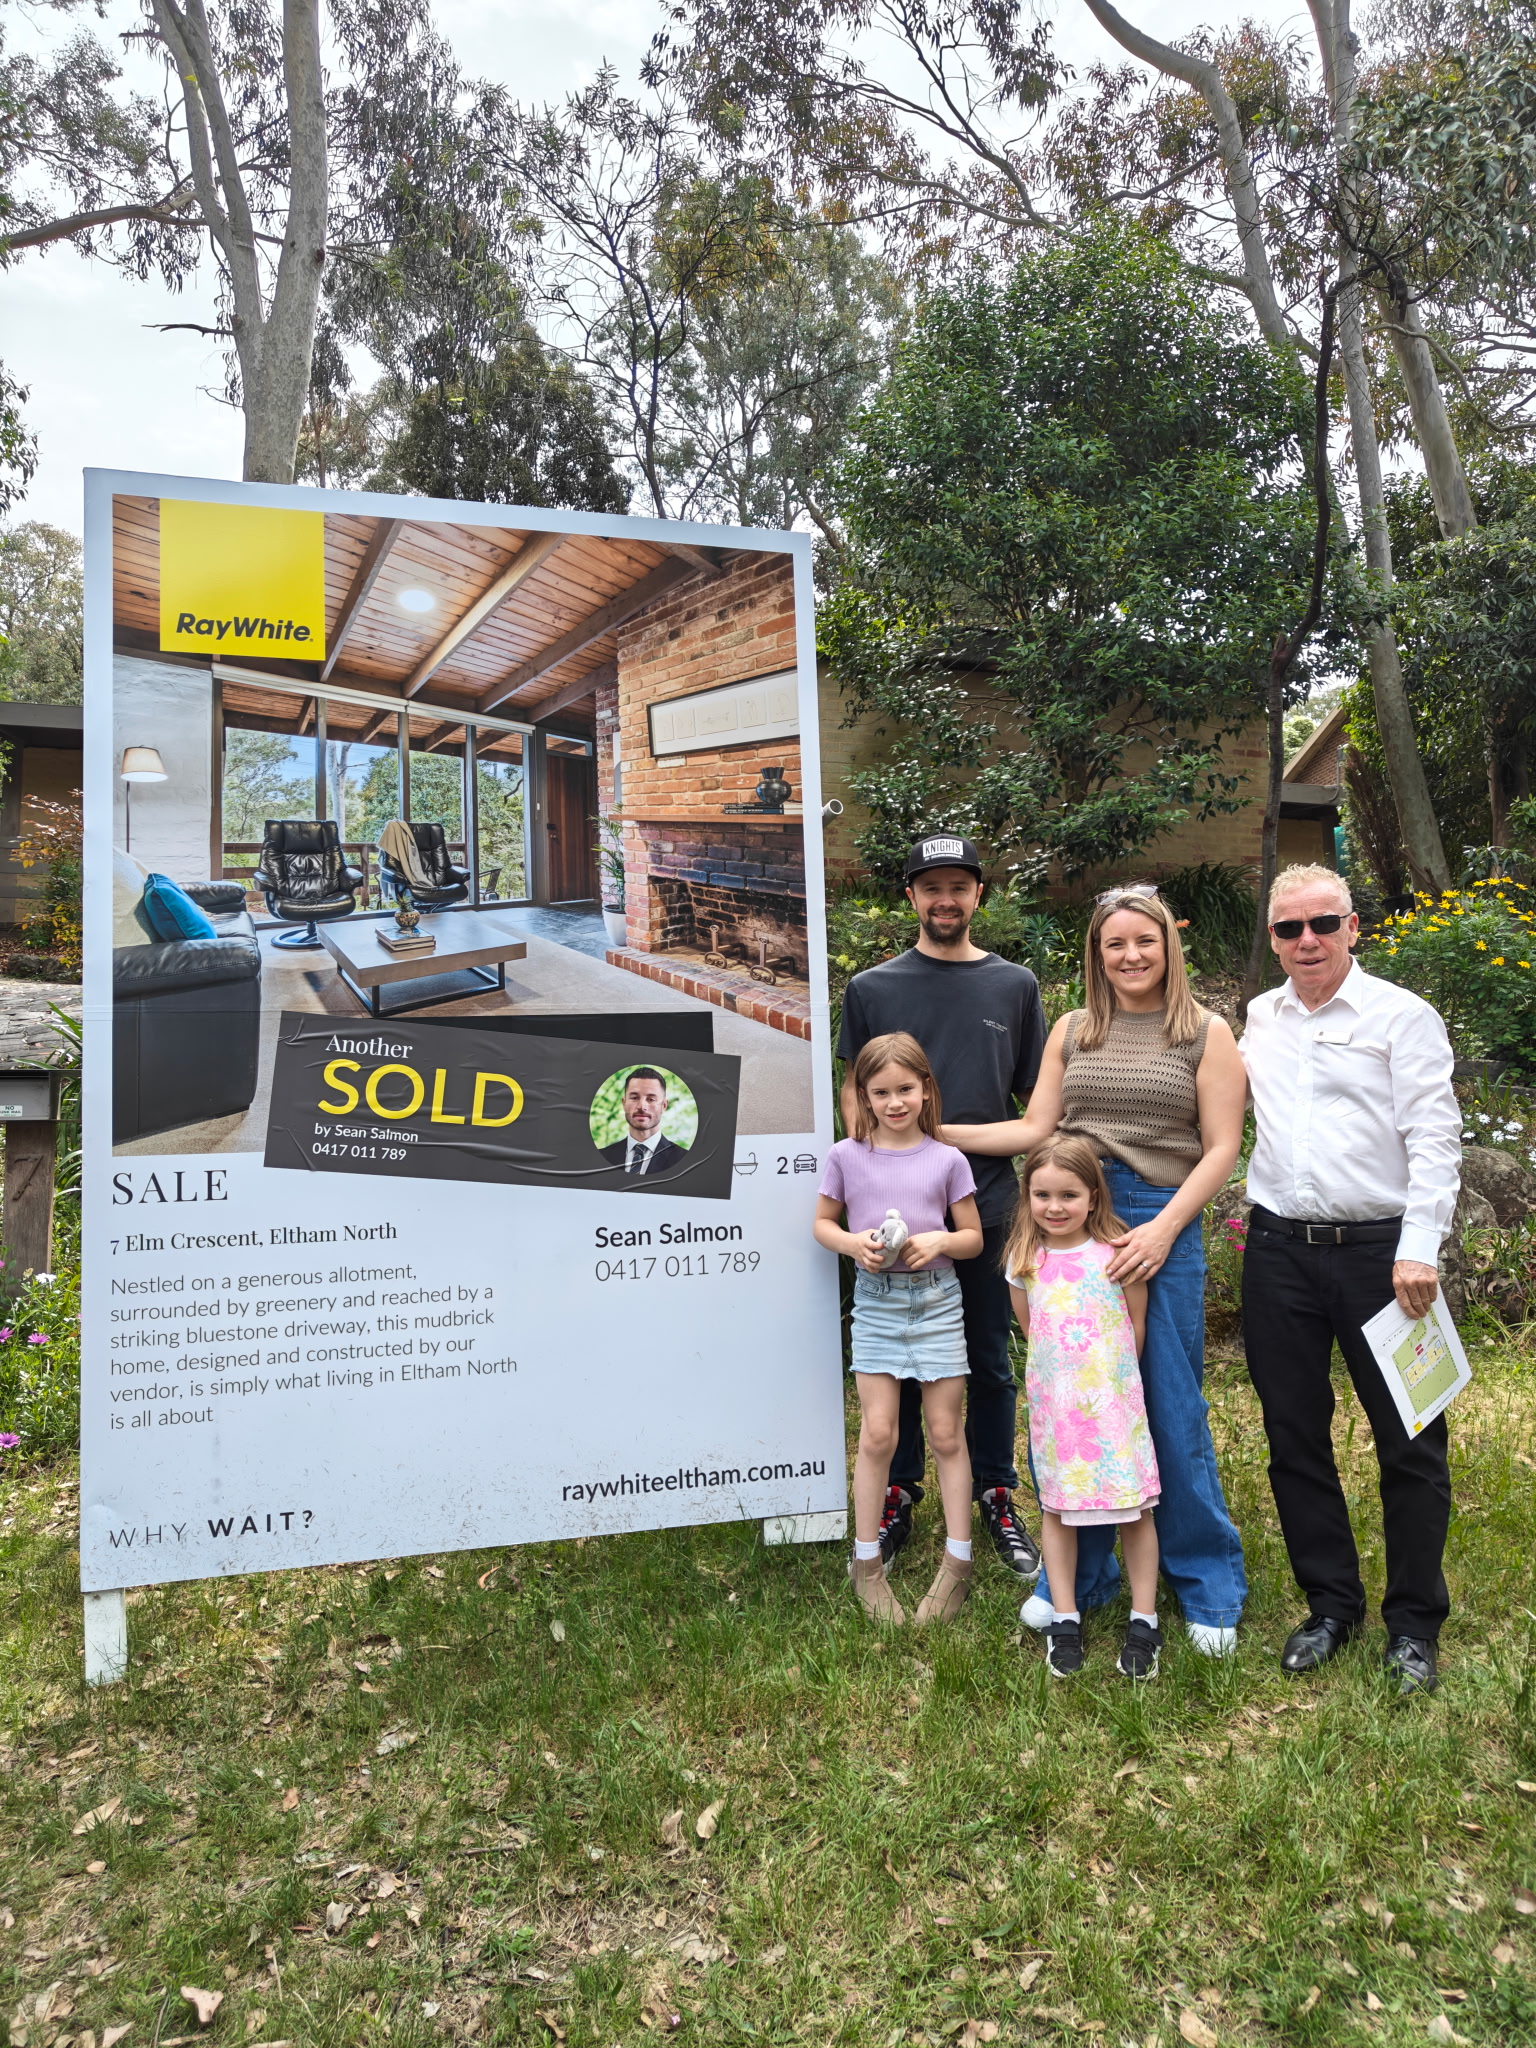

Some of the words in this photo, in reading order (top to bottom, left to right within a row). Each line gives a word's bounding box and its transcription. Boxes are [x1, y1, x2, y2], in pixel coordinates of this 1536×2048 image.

[925, 840, 962, 855] KNIGHTS
[324, 1034, 414, 1059] Another
[317, 1058, 524, 1128] SOLD
[314, 1122, 332, 1138] by
[334, 1124, 367, 1139] Sean
[369, 1127, 419, 1144] Salmon
[312, 1142, 348, 1157] 0417
[350, 1145, 377, 1159] 011
[381, 1147, 407, 1161] 789
[776, 1156, 789, 1175] 2
[112, 1169, 228, 1205] SALE
[110, 1239, 120, 1256] 7
[125, 1233, 165, 1252] Elm
[170, 1230, 264, 1250] Crescent,
[270, 1226, 337, 1245] Eltham
[343, 1222, 398, 1241] North
[595, 1226, 652, 1249] Sean
[659, 1221, 743, 1245] Salmon
[111, 1274, 184, 1296] Nestled
[191, 1277, 215, 1291] on
[221, 1276, 231, 1290] a
[237, 1271, 323, 1292] generous
[328, 1263, 417, 1284] allotment,
[595, 1257, 657, 1282] 0417
[665, 1254, 709, 1278] 011
[717, 1250, 761, 1274] 789
[110, 1300, 220, 1323] surrounded
[227, 1298, 250, 1318] by
[255, 1297, 337, 1317] greenery
[342, 1290, 375, 1308] and
[382, 1285, 452, 1306] reached
[458, 1284, 479, 1304] by
[484, 1287, 493, 1300] a
[110, 1329, 180, 1349] striking
[186, 1325, 278, 1344] bluestone
[284, 1320, 371, 1338] driveway,
[376, 1314, 409, 1332] this
[414, 1308, 495, 1329] mudbrick
[111, 1358, 170, 1376] home,
[176, 1349, 260, 1372] designed
[266, 1346, 300, 1365] and
[306, 1340, 413, 1362] constructed
[419, 1338, 441, 1357] by
[446, 1338, 476, 1352] our
[110, 1382, 183, 1403] vendor,
[190, 1380, 204, 1397] is
[210, 1375, 270, 1397] simply
[275, 1372, 321, 1390] what
[327, 1368, 374, 1388] living
[379, 1366, 395, 1383] in
[401, 1363, 461, 1381] Eltham
[467, 1356, 517, 1376] North
[110, 1413, 125, 1430] is
[131, 1409, 151, 1428] all
[158, 1406, 214, 1426] about
[562, 1460, 826, 1504] raywhiteeltham.com.au
[109, 1522, 187, 1549] WHY
[207, 1509, 313, 1538] WAIT?
